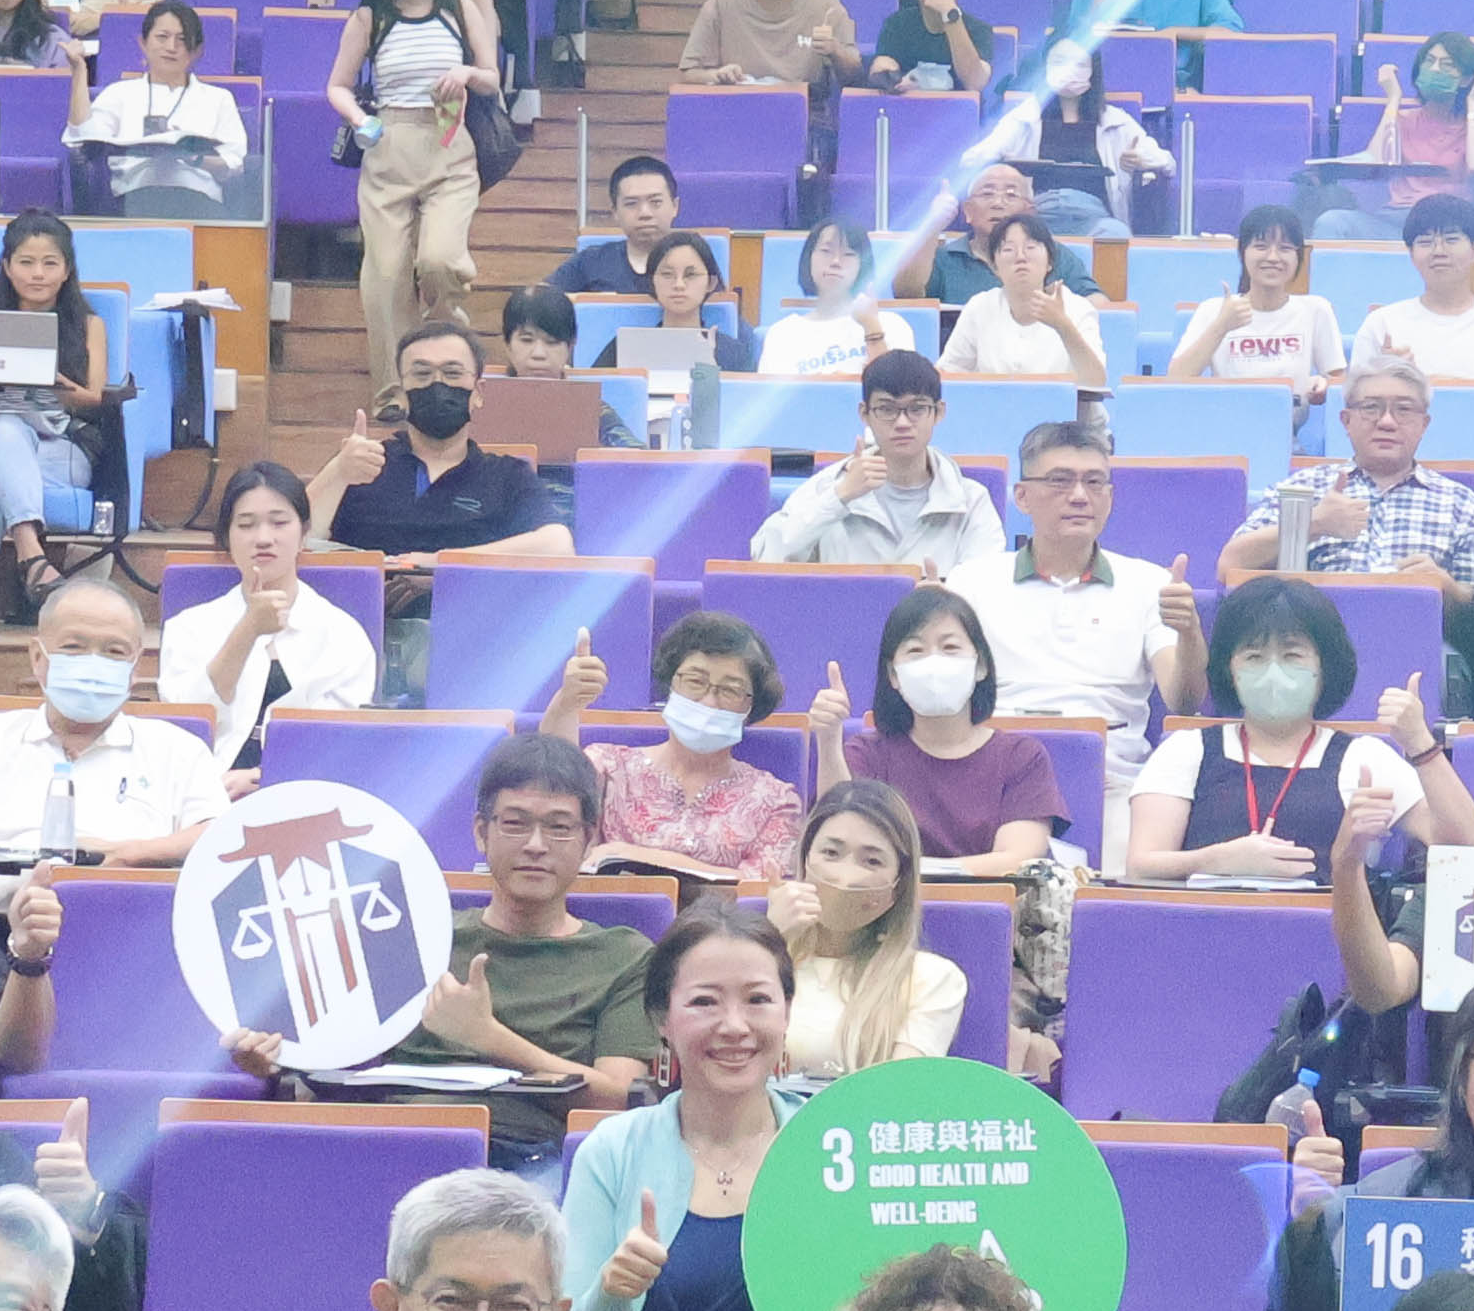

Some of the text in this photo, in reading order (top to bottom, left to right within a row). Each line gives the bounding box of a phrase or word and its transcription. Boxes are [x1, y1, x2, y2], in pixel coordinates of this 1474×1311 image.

[868, 1118, 1038, 1155] 健康與福祉
[822, 1127, 856, 1193] 3
[868, 1162, 1030, 1188] GOOD HEALTH AND
[870, 1200, 978, 1226] WELL-BEING
[1366, 1221, 1424, 1290] 16
